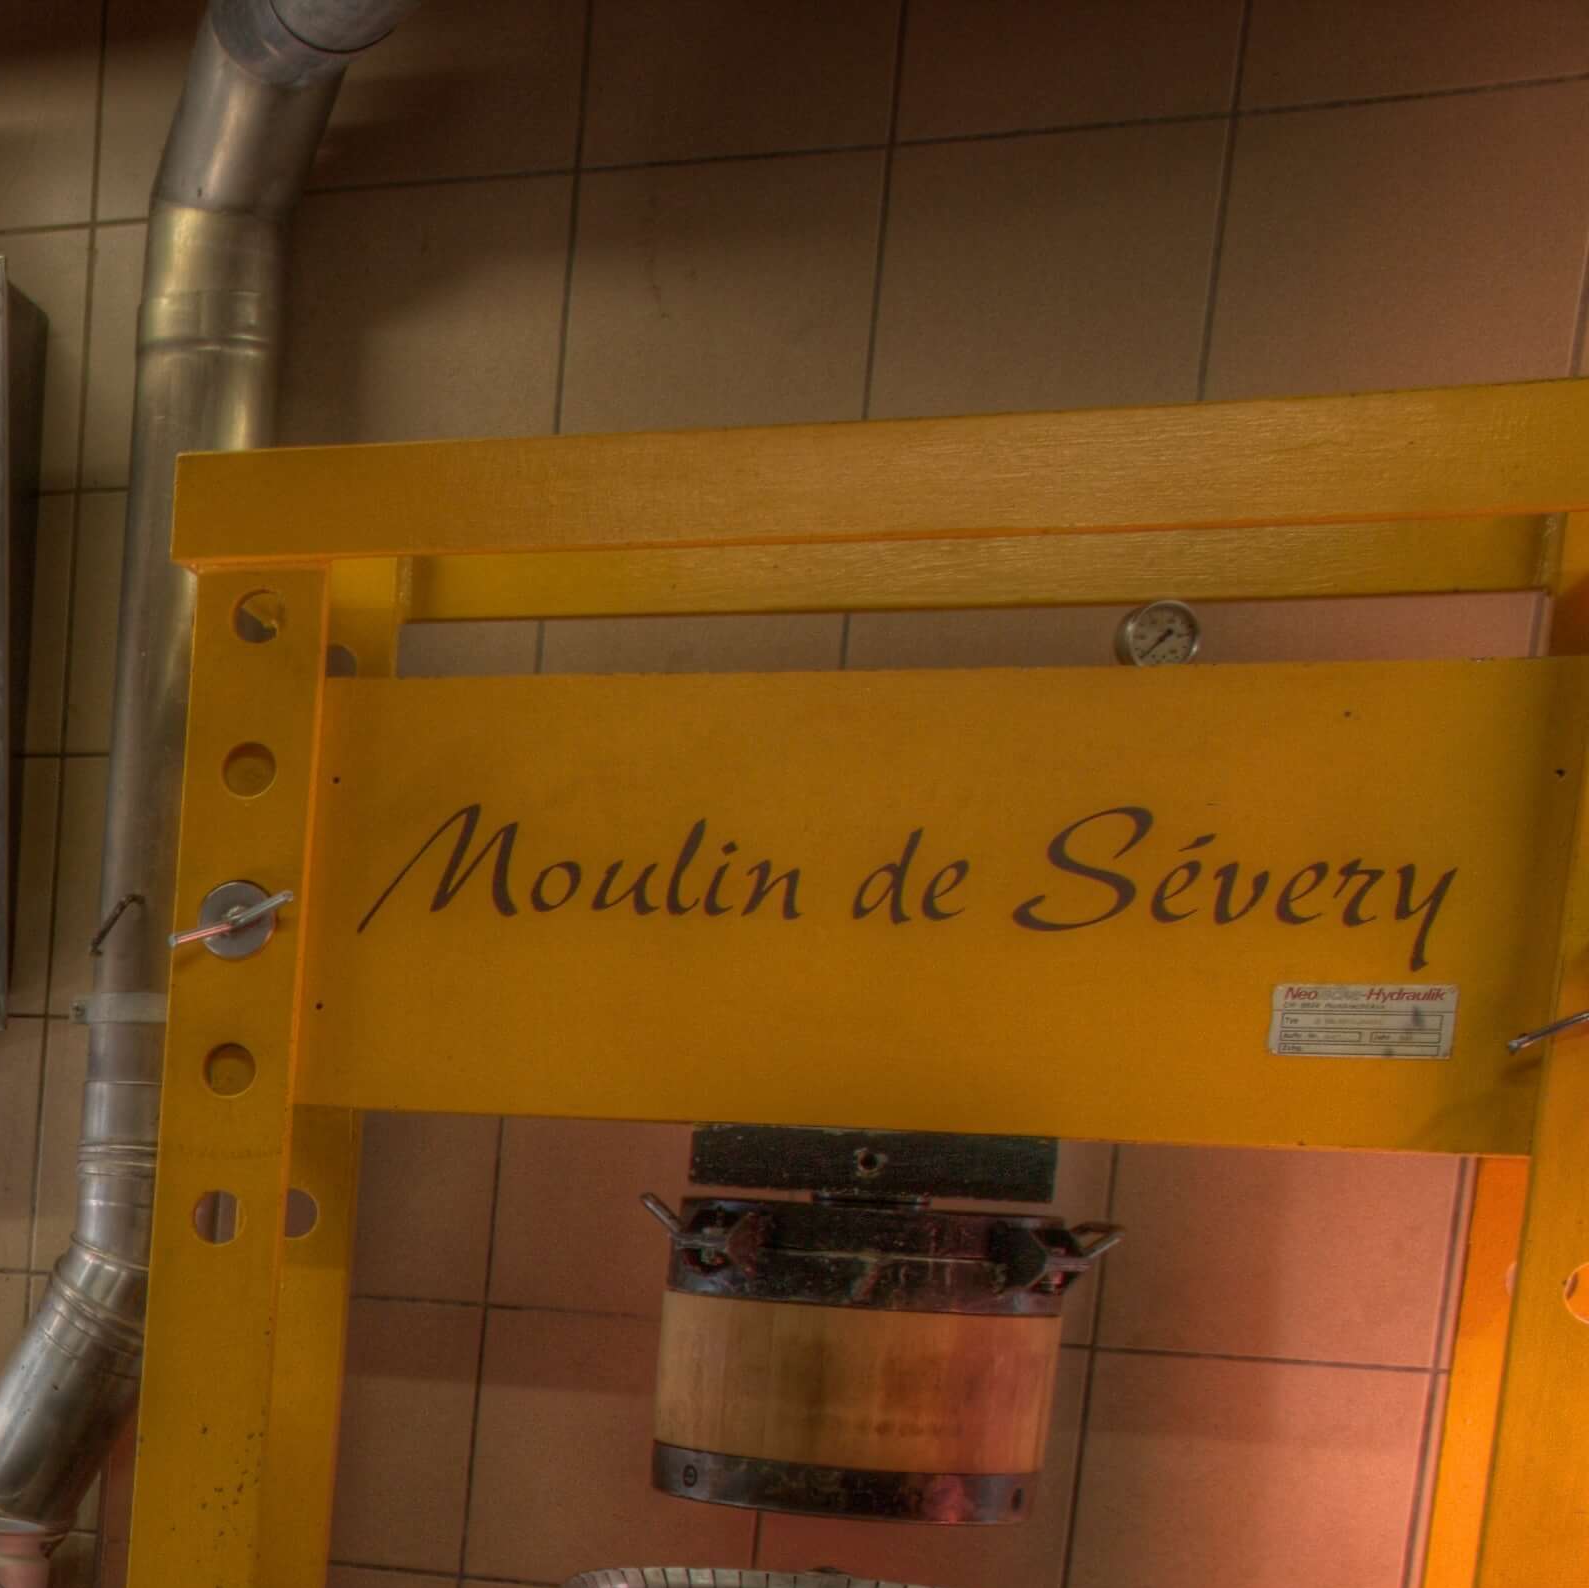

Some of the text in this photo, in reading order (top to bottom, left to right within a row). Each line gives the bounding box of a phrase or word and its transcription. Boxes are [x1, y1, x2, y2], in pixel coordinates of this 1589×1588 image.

[357, 803, 1458, 972] Moulin de Sévery
